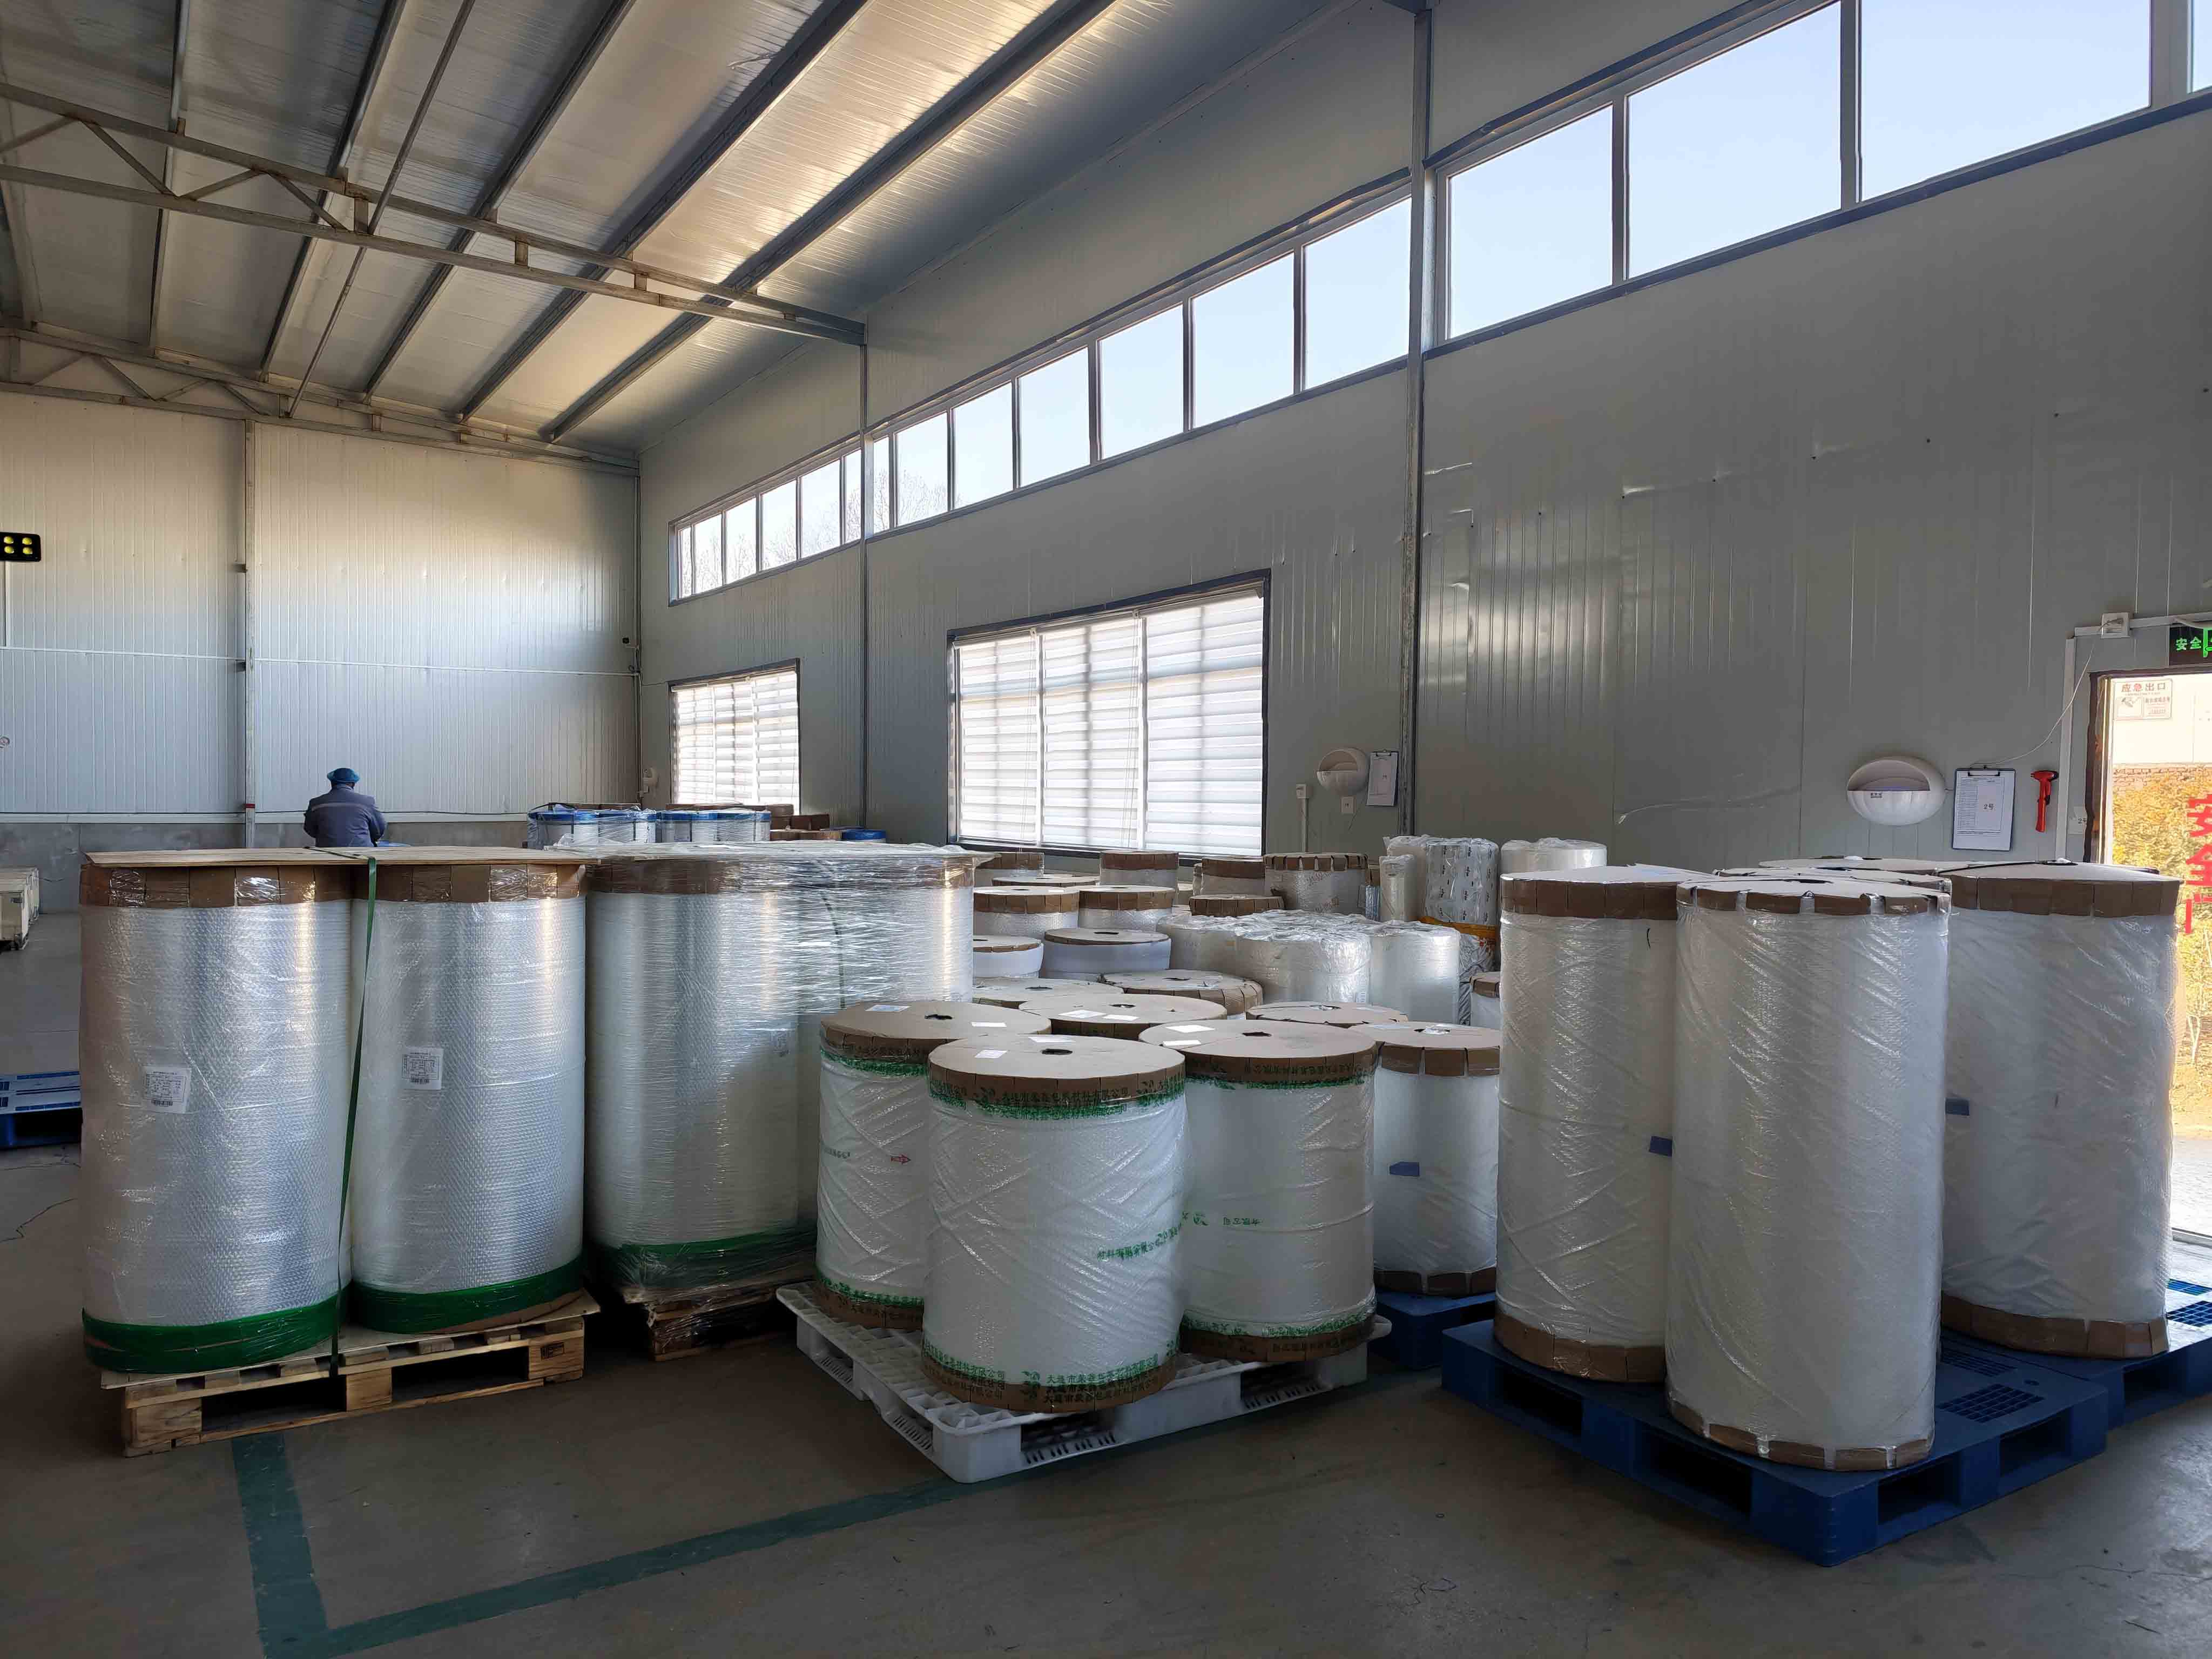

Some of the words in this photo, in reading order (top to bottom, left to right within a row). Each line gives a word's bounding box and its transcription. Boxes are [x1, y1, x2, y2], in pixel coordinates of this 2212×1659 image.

[2175, 637, 2202, 651] 安全
[2121, 682, 2166, 692] 应急出口
